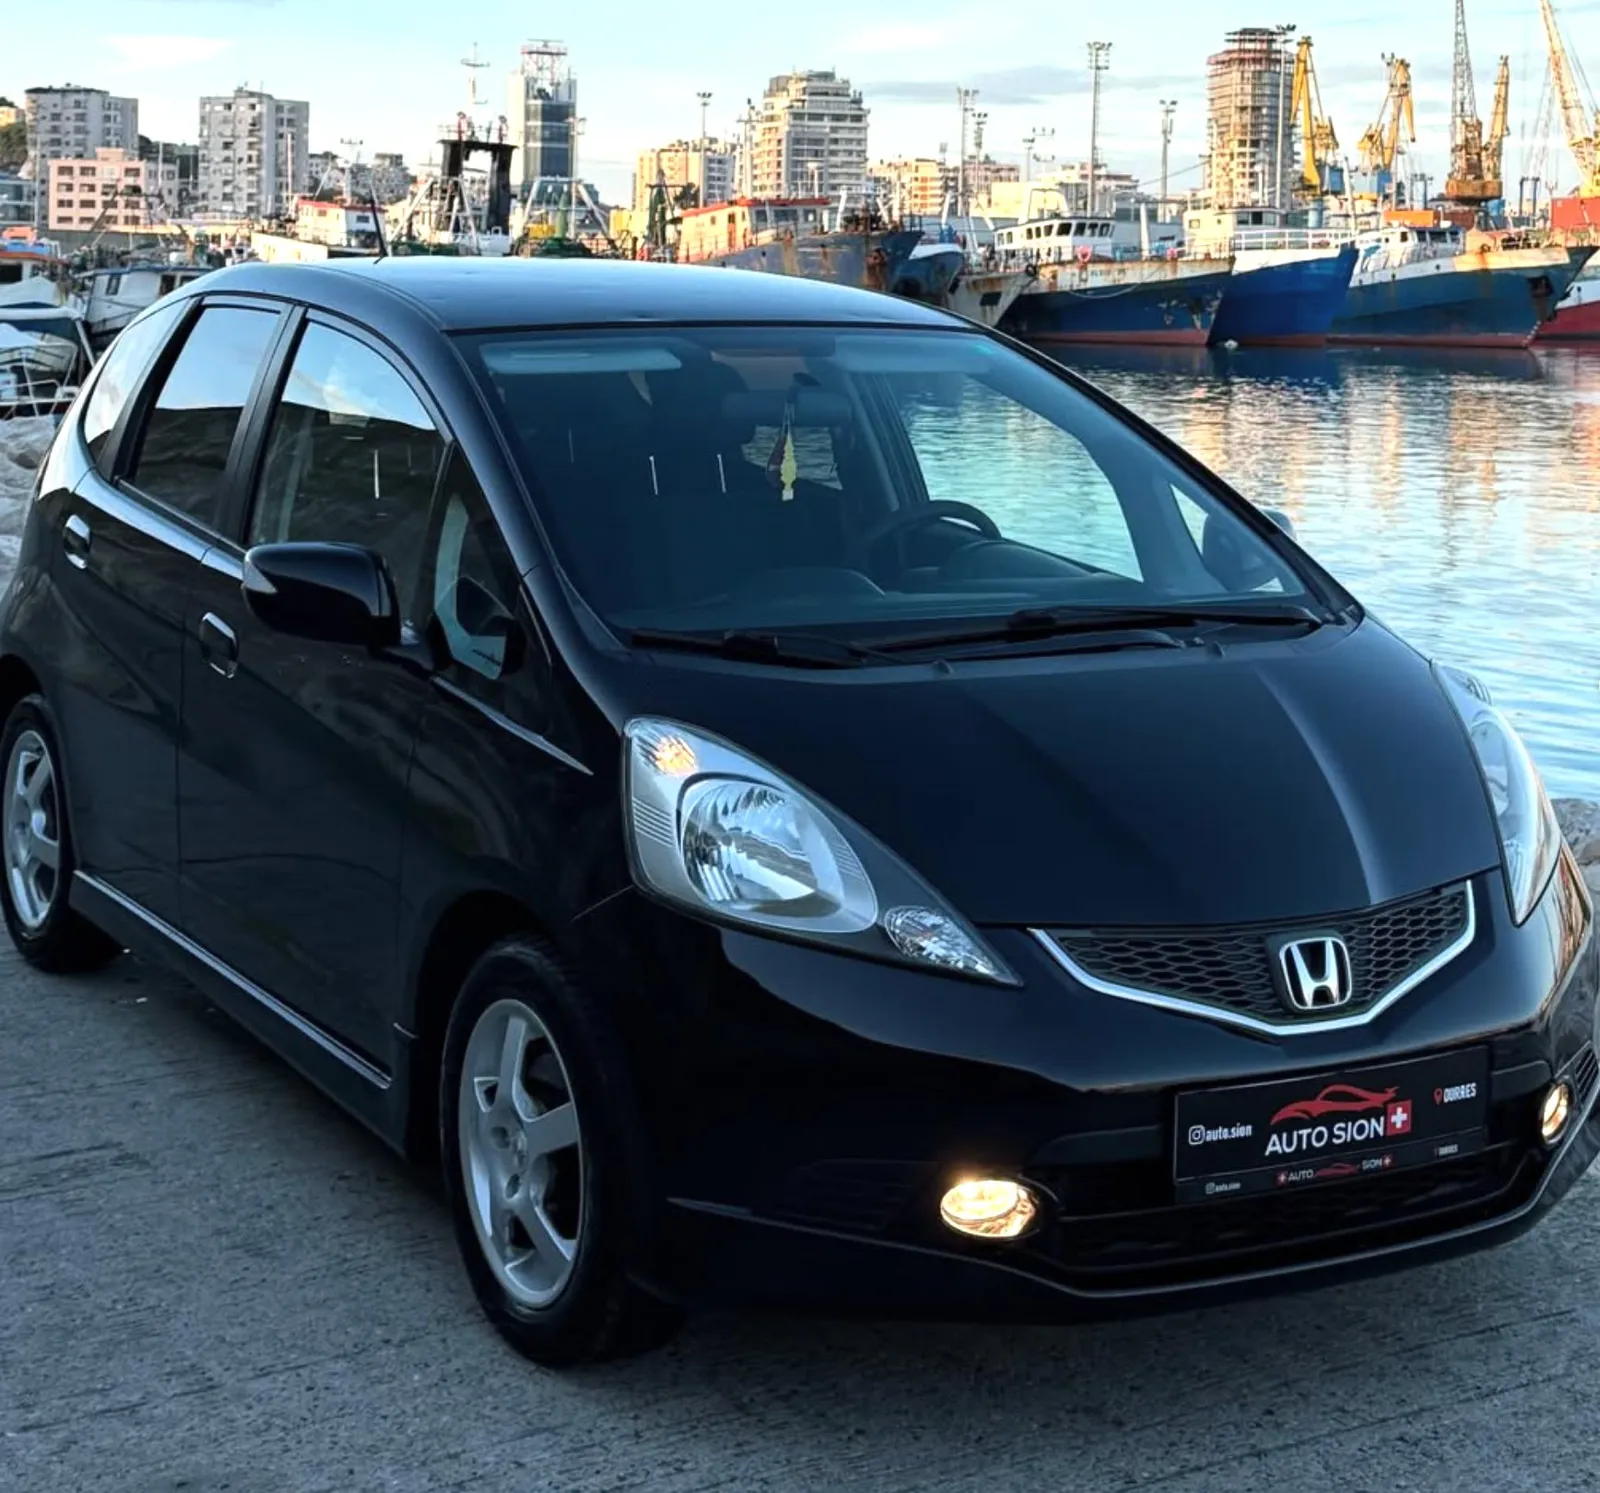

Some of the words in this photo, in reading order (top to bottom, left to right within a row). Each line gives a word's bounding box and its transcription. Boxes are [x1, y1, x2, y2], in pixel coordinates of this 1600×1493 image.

[1205, 1122, 1253, 1142] auto.sion
[1265, 1126, 1328, 1156] AUTO
[1332, 1116, 1385, 1144] SION
[1288, 1169, 1314, 1182] AUTO
